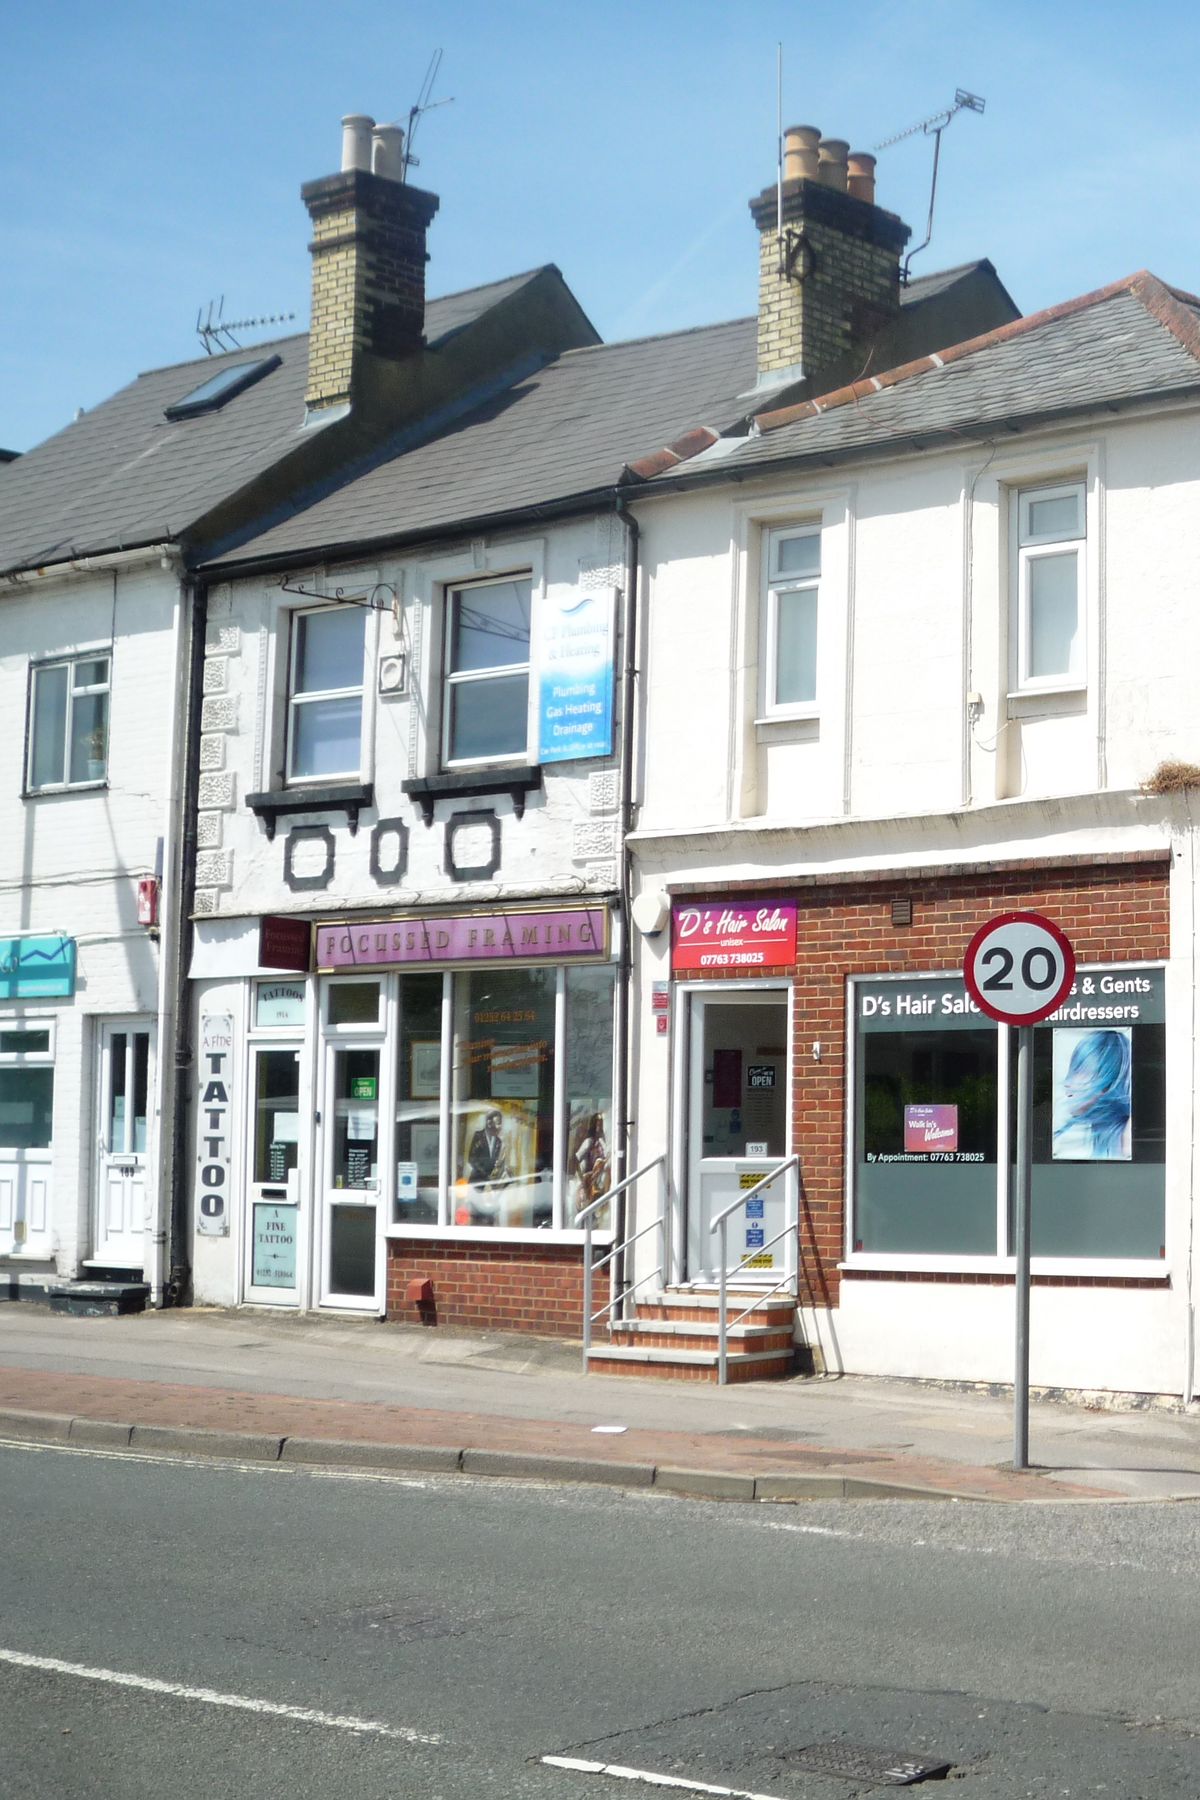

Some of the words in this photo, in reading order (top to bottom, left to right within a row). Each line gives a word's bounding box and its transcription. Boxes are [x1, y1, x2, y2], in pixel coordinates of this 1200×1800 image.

[553, 683, 596, 697] Plumbing
[546, 705, 563, 718] Gas
[565, 701, 603, 716] Heating
[553, 722, 594, 736] Drainage
[679, 908, 713, 938] D's
[716, 909, 748, 935] Hair
[751, 908, 788, 932] Salon
[326, 929, 450, 954] FOCUSSED
[467, 922, 593, 947] FRAMING
[720, 938, 744, 947] unisex
[700, 954, 728, 965] 07763
[730, 952, 764, 964] 738025
[981, 946, 1058, 991] 20
[1082, 976, 1096, 995] &
[1100, 975, 1151, 994] Gents
[263, 987, 305, 1002] TATTOOS
[862, 996, 891, 1016] D's
[896, 995, 936, 1015] Hair
[941, 992, 981, 1014] Salo
[1045, 1003, 1140, 1021] airdressers
[203, 1037, 210, 1048] A
[751, 1076, 772, 1086] OPEN
[354, 1086, 372, 1097] OPEN
[908, 1120, 925, 1128] Walk
[926, 1120, 937, 1128] in's
[200, 1053, 229, 1217] TATTOO
[924, 1127, 954, 1142] Welcome
[867, 1153, 876, 1163] By
[878, 1153, 929, 1163] Appointment:
[930, 1153, 954, 1162] 07763
[956, 1153, 985, 1162] 738025
[274, 1209, 279, 1218] A
[266, 1221, 286, 1231] FINE
[259, 1233, 293, 1244] TATTOO
